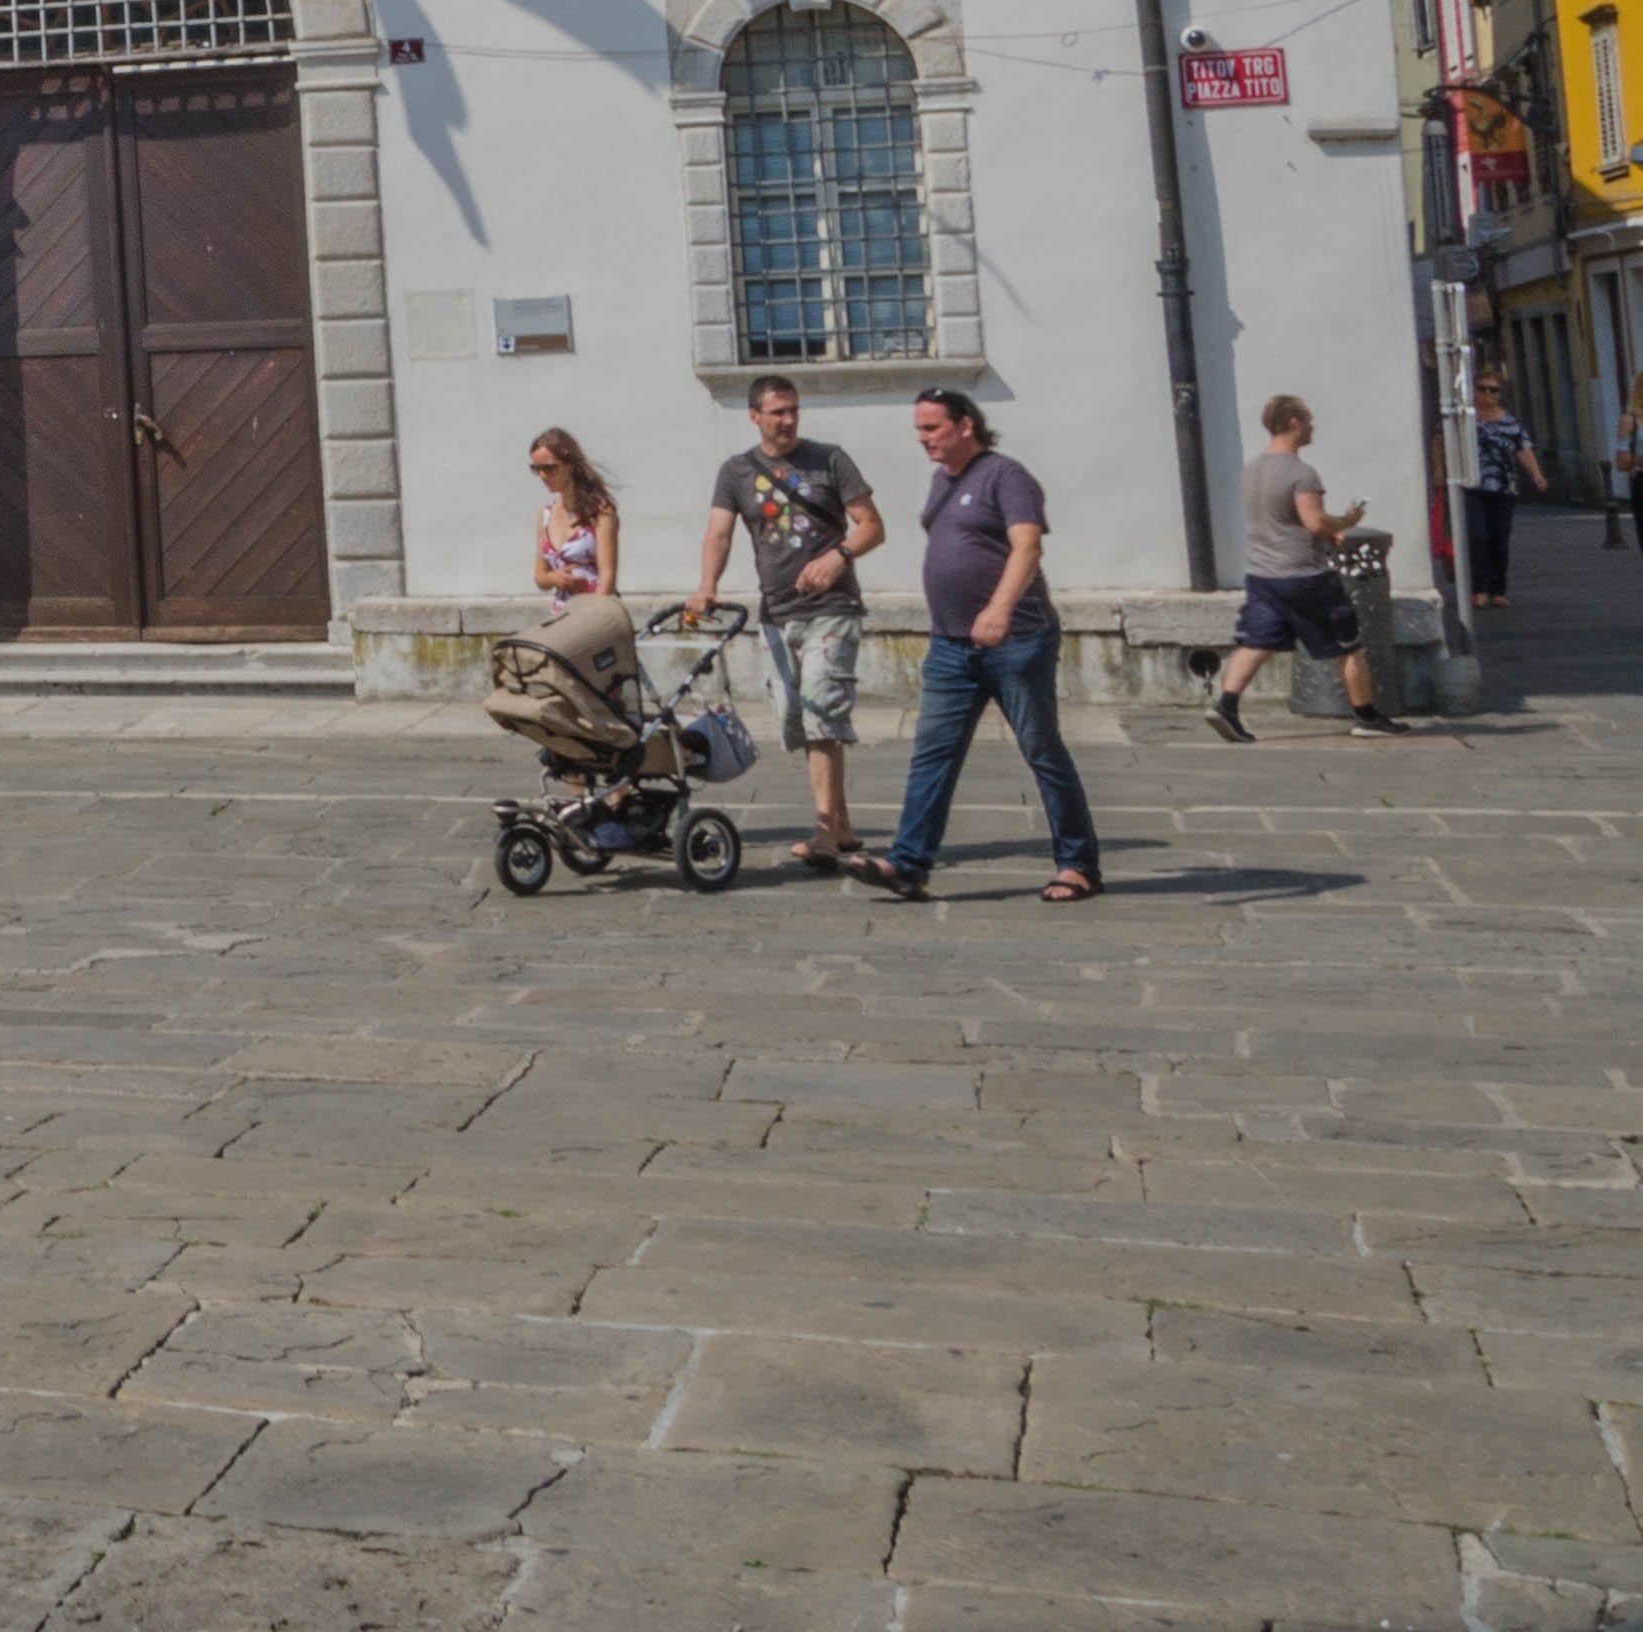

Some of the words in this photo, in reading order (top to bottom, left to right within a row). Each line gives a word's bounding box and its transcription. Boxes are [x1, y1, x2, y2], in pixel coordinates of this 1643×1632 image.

[1190, 58, 1235, 80] TITOV
[1242, 56, 1275, 76] TRG
[1187, 80, 1241, 101] PIAZZA
[1244, 77, 1282, 97] TITO
